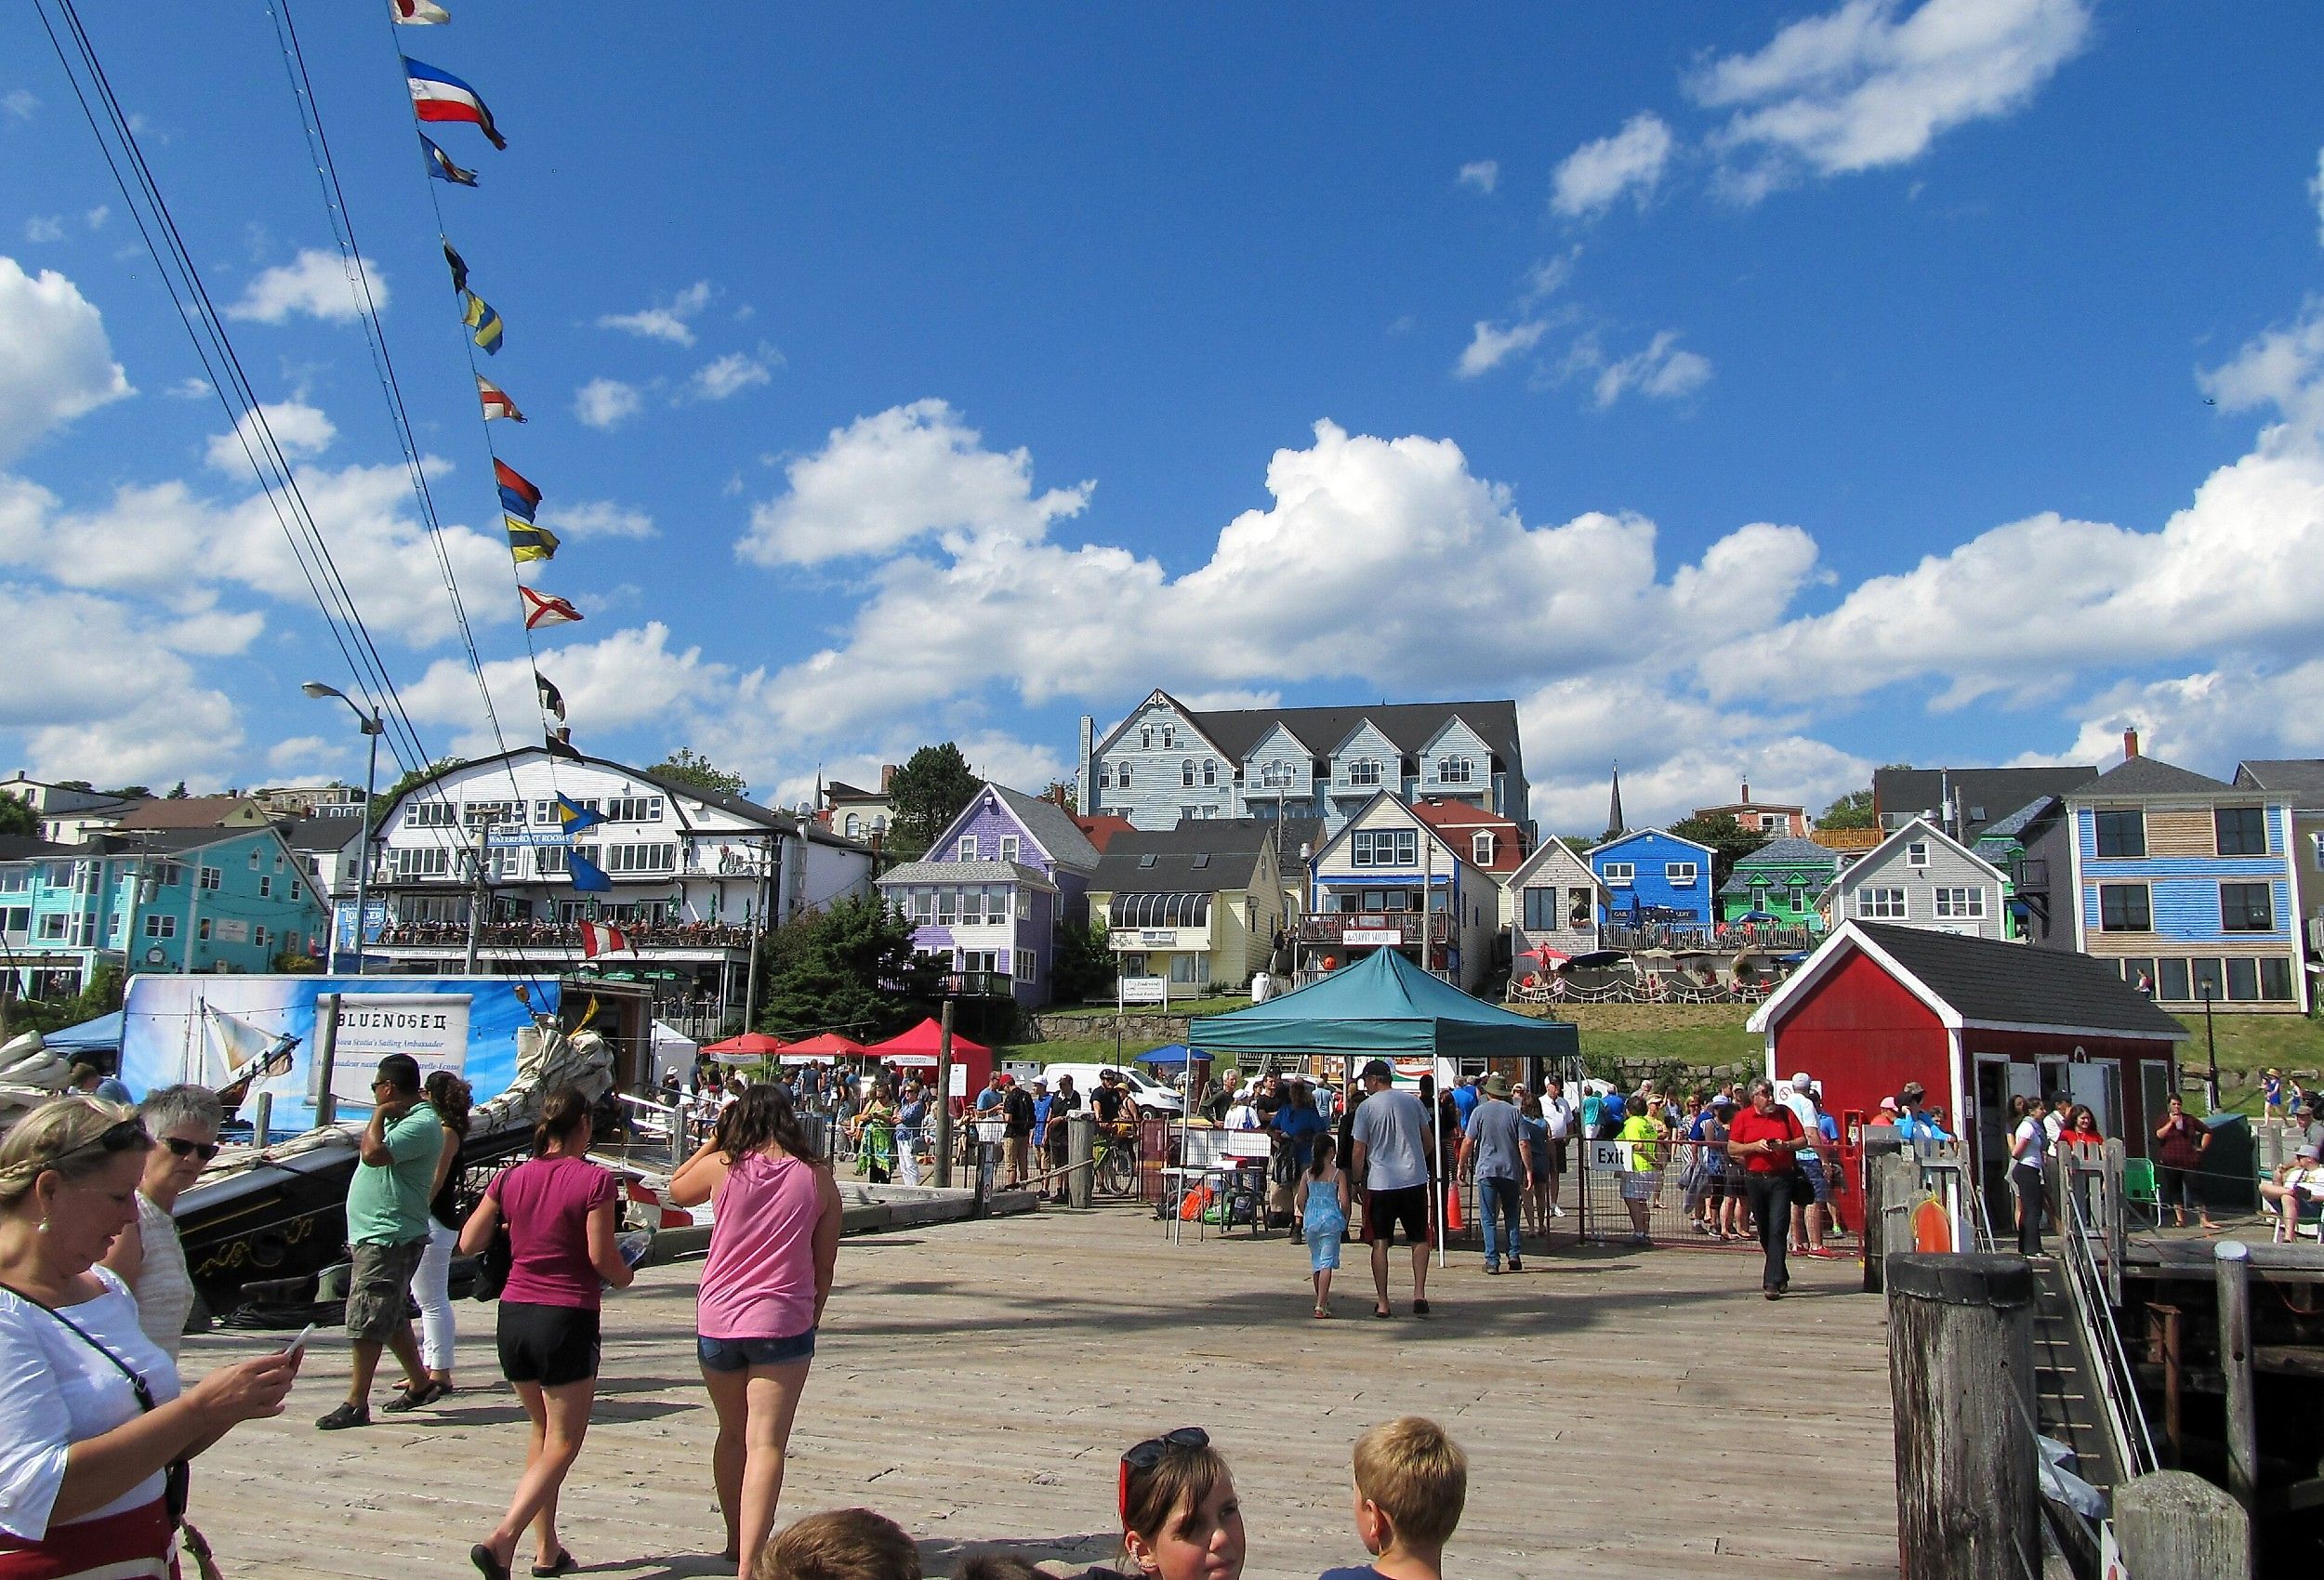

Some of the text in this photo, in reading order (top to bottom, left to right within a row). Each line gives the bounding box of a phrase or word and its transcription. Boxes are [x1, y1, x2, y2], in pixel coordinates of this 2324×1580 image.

[337, 1013, 429, 1029] BLUENOSE
[403, 1039, 443, 1047] Ambassador
[1598, 1148, 1624, 1165] Exit
